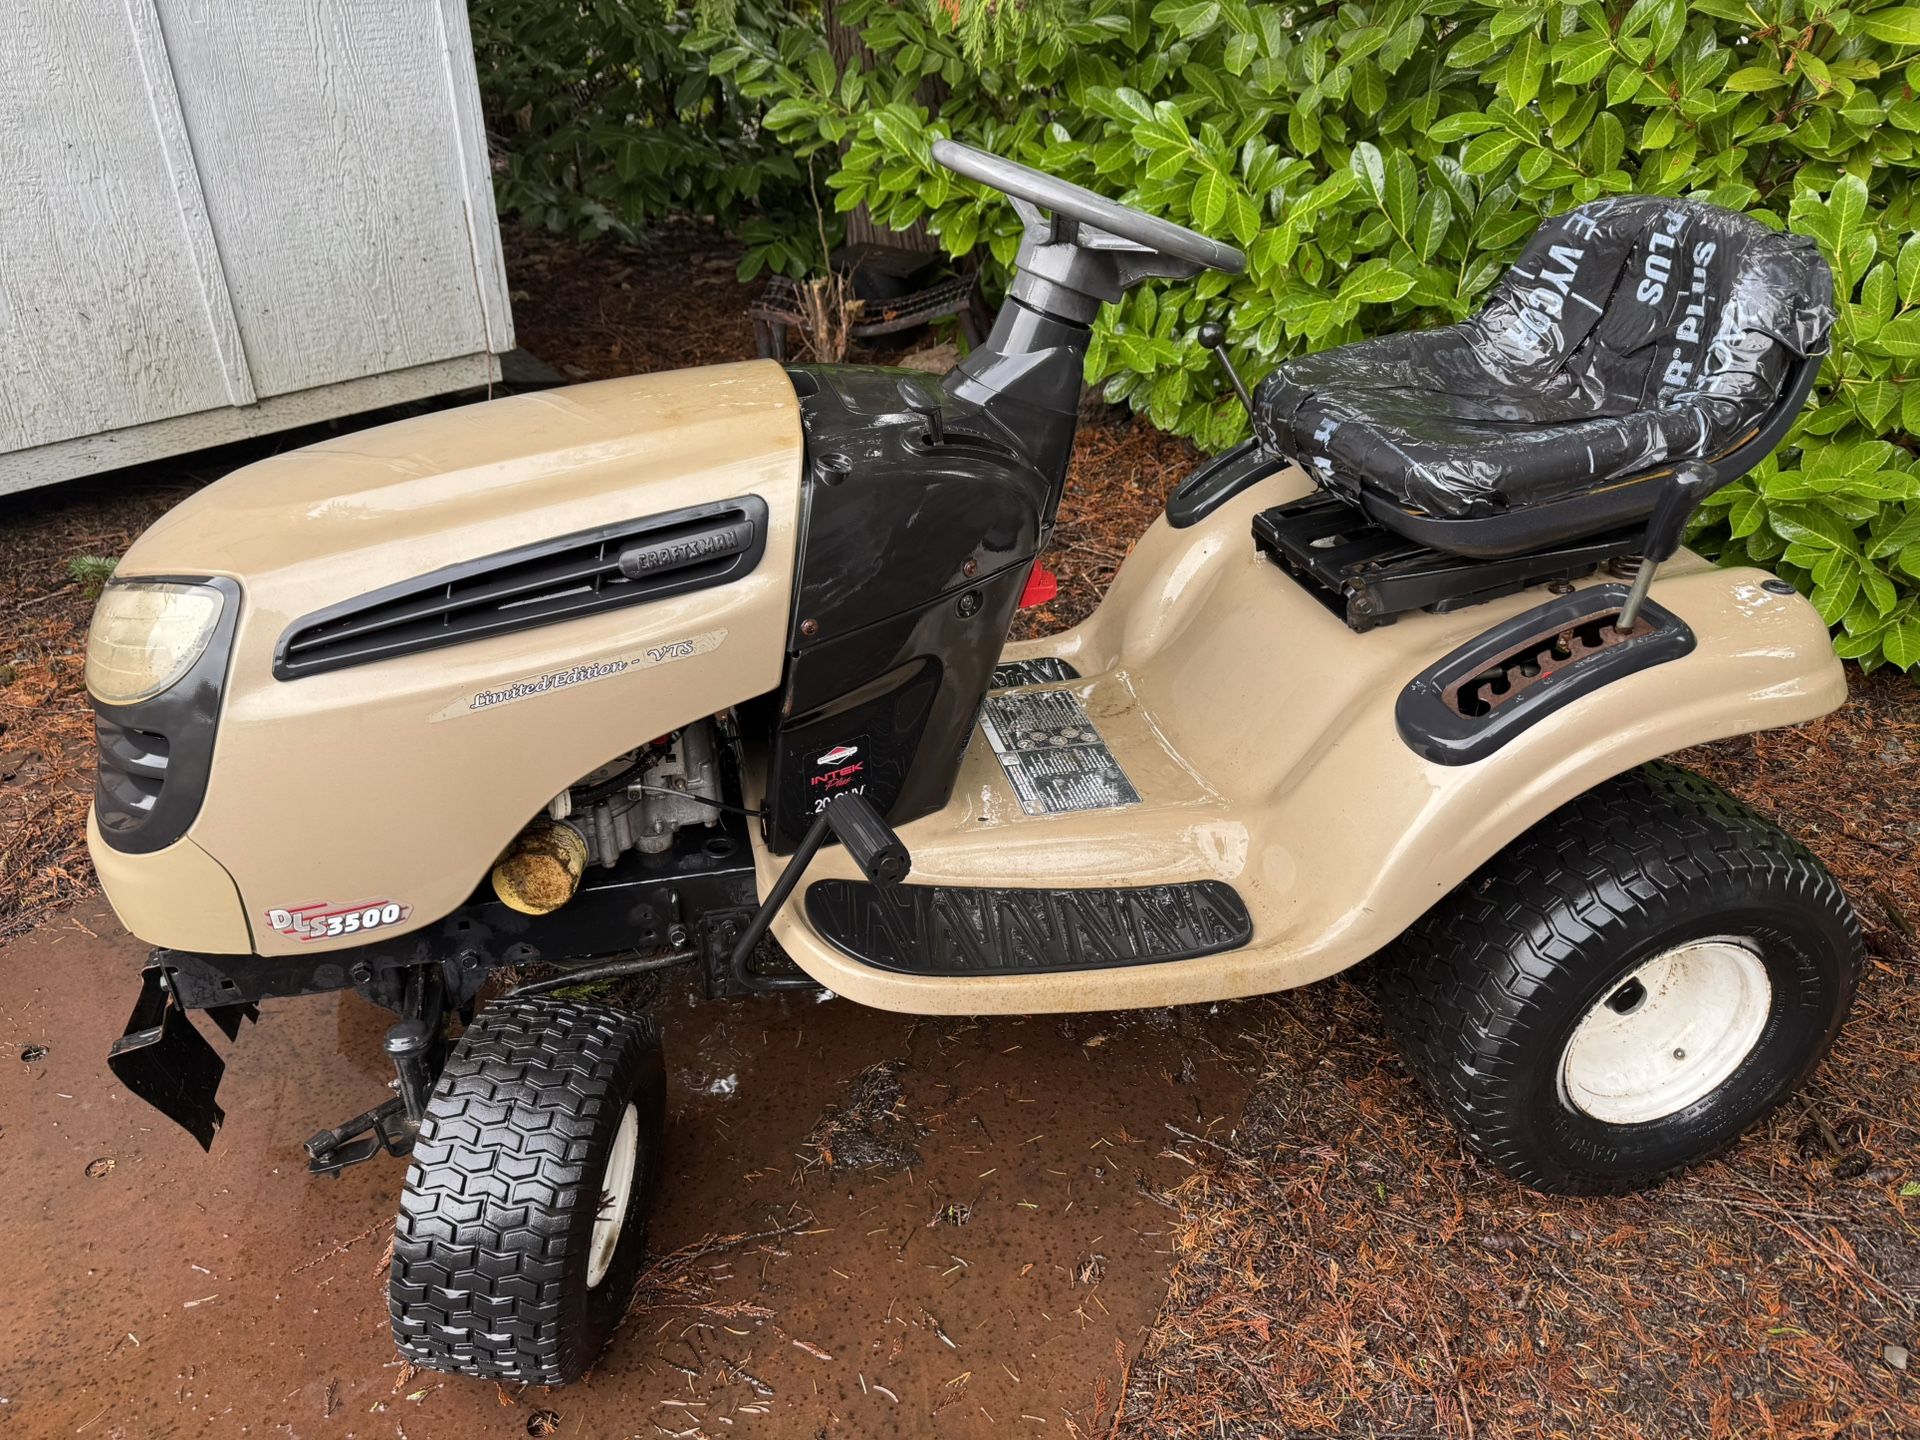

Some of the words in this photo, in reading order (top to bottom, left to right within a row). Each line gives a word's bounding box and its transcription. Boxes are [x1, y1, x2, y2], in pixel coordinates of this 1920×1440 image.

[1636, 208, 1689, 306] PLUS
[1675, 241, 1717, 344] PLUS
[637, 530, 739, 571] CRAFTSMAN
[470, 675, 554, 709] Limited
[551, 660, 628, 688] Edition
[647, 640, 694, 662] VTS
[811, 761, 865, 786] INTEK
